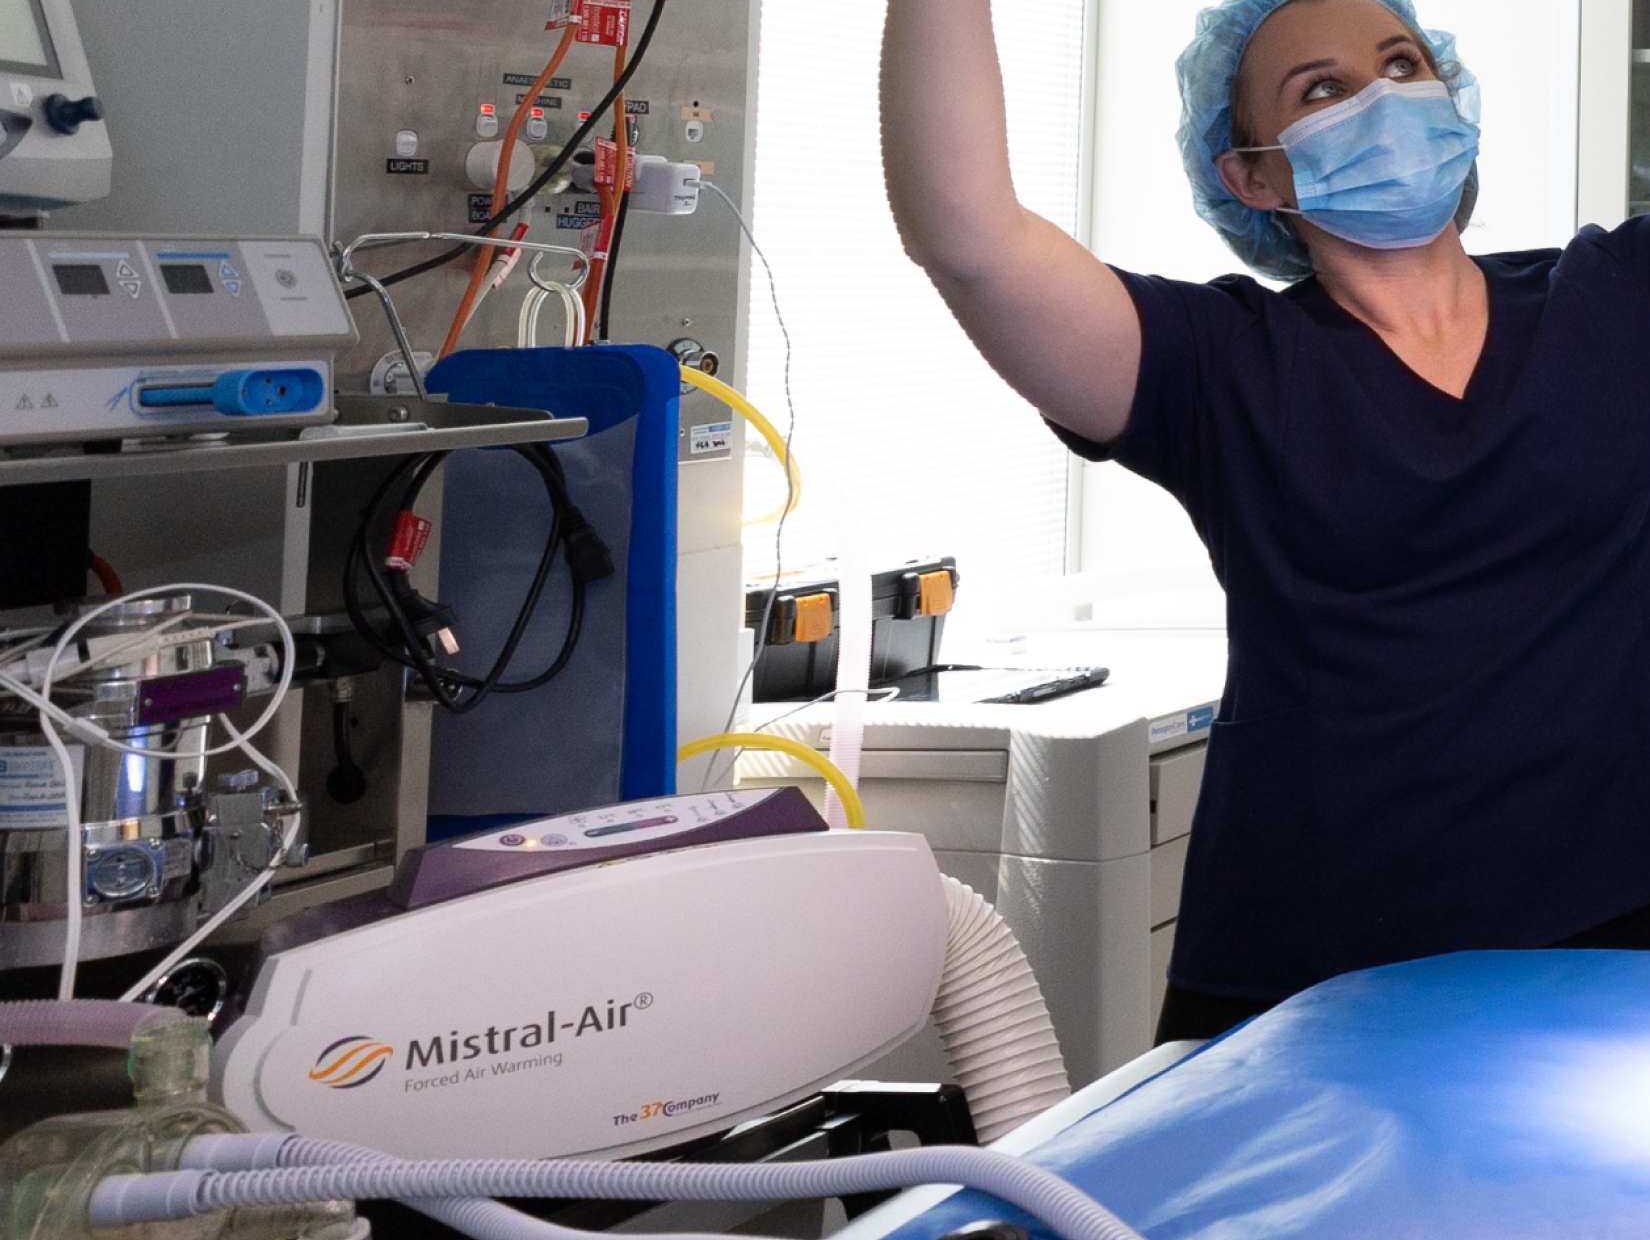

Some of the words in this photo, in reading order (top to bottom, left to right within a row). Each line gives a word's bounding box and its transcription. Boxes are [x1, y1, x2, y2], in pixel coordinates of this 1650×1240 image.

[390, 161, 424, 172] LIGHTS
[577, 203, 600, 214] BAIR
[403, 1070, 461, 1094] Forced
[464, 1065, 487, 1082] Air
[490, 1052, 564, 1076] Warming
[612, 1110, 638, 1127] The
